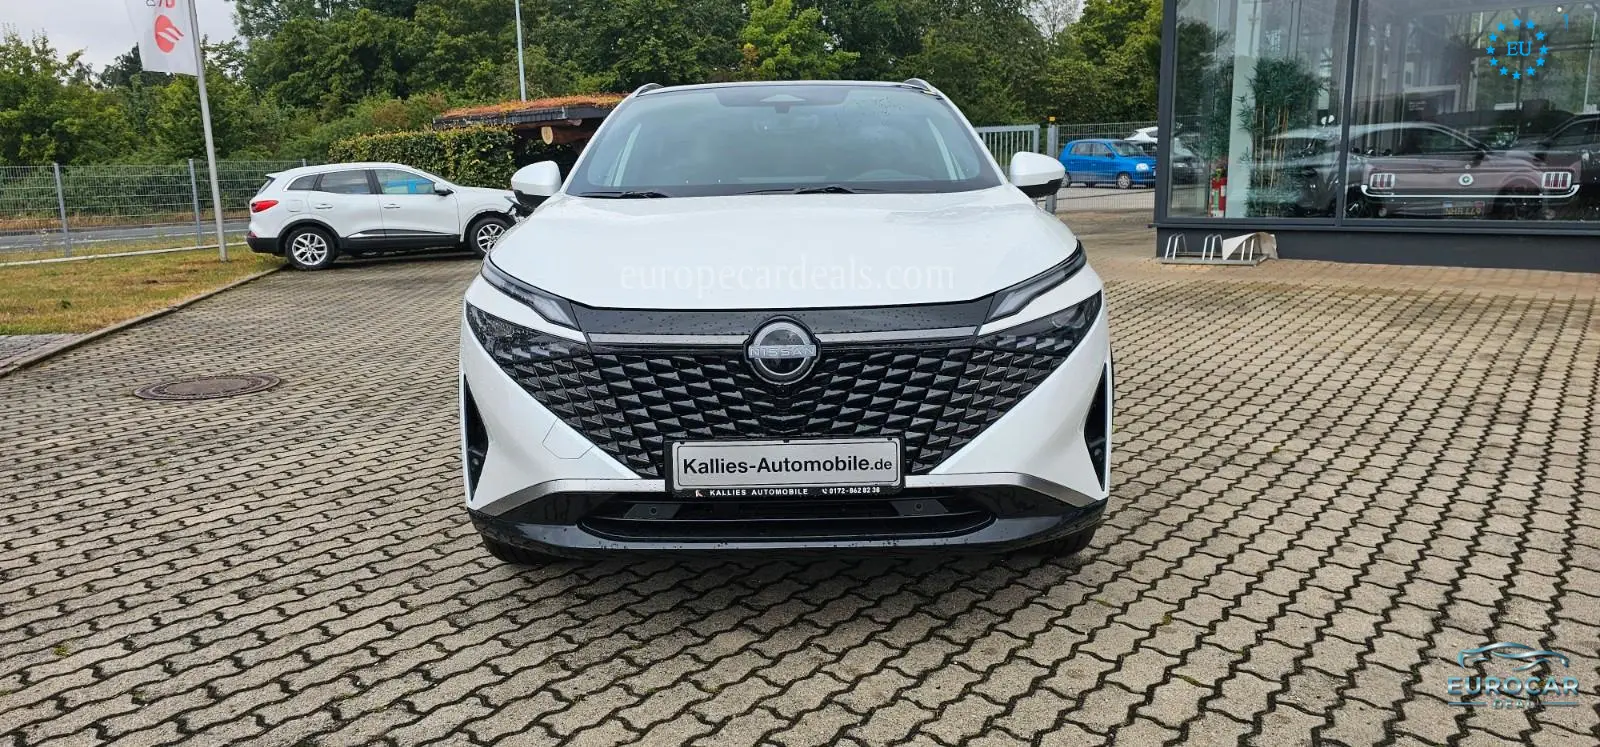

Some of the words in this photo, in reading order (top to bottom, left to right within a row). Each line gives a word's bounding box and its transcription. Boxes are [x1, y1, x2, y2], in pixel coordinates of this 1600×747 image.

[750, 346, 814, 357] NISSAN
[683, 455, 893, 475] Kallies-Automobile.de
[709, 489, 747, 497] KALLIES
[751, 488, 809, 496] AUTOMOBILE
